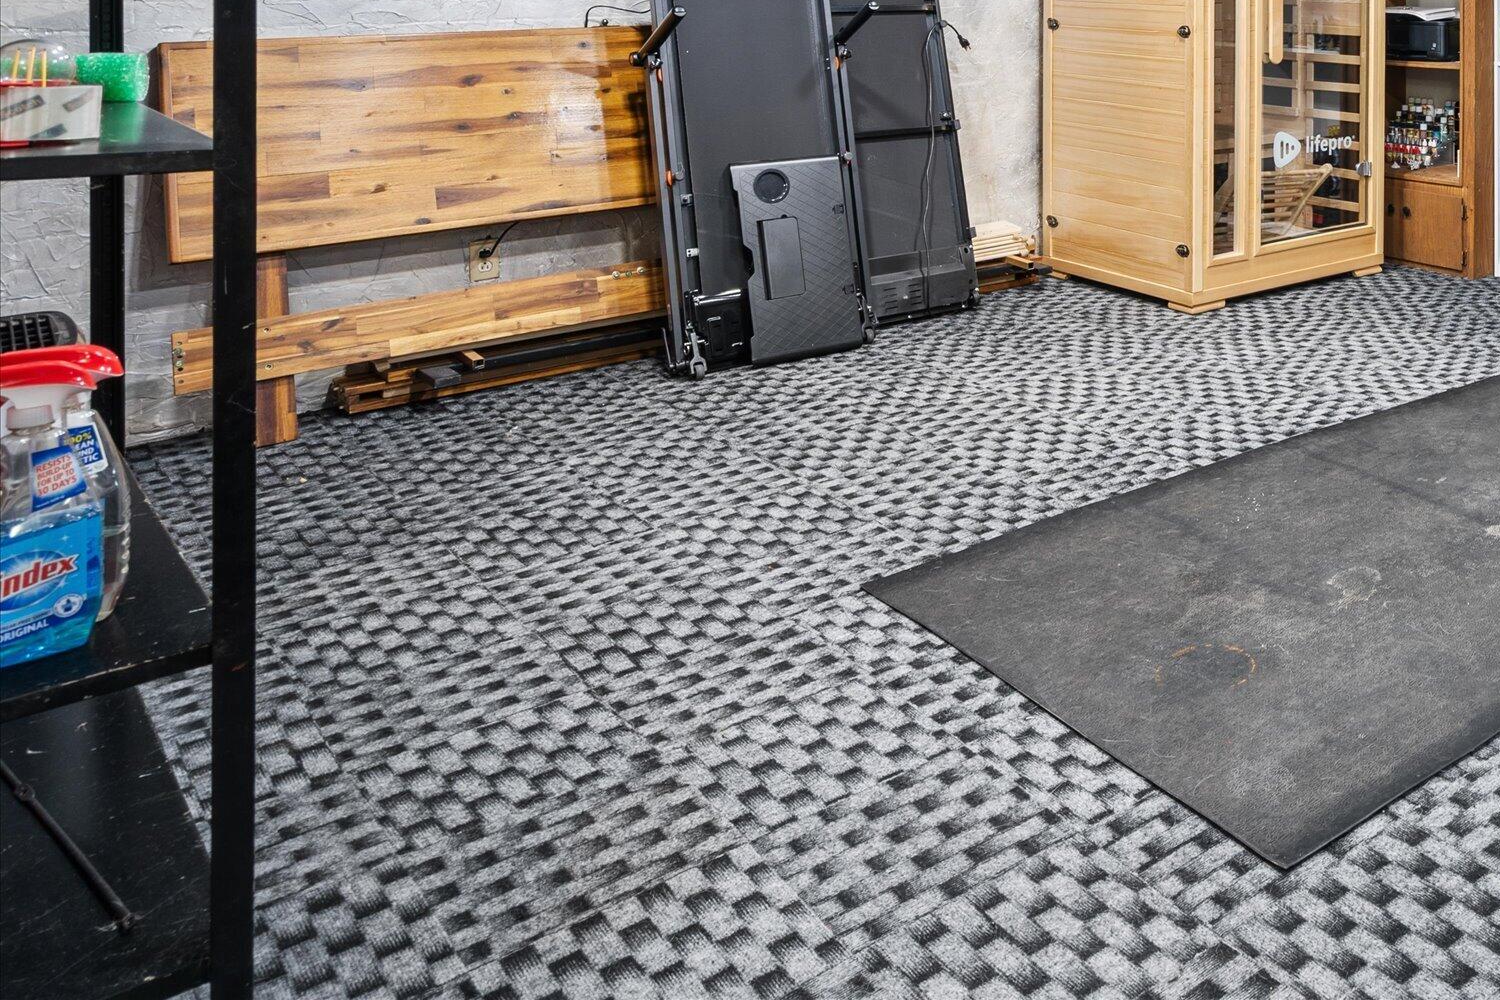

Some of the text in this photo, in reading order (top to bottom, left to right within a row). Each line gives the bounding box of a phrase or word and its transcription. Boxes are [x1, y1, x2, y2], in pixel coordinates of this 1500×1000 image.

[1306, 134, 1353, 156] lifepro
[35, 454, 71, 473] RESISTS
[52, 475, 78, 491] DAYS
[53, 472, 64, 481] UP
[65, 467, 75, 476] TO
[0, 554, 79, 598] ndex
